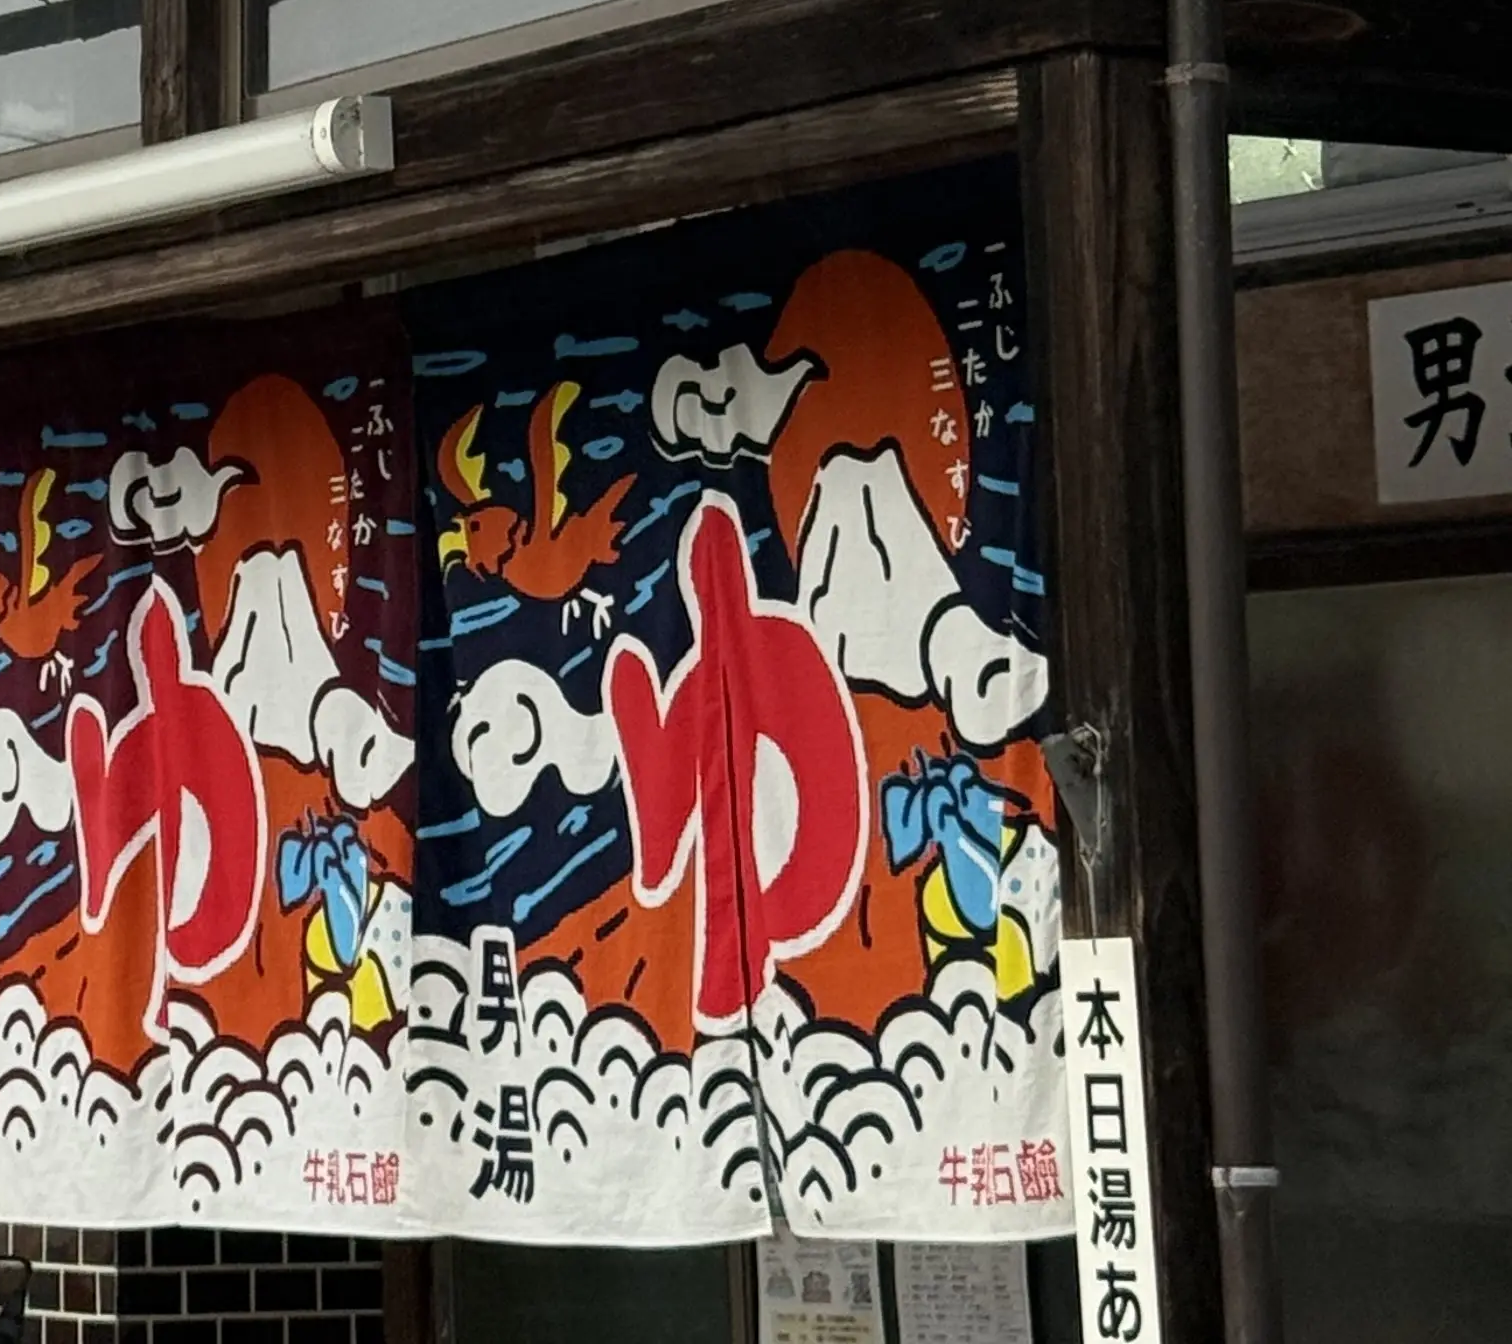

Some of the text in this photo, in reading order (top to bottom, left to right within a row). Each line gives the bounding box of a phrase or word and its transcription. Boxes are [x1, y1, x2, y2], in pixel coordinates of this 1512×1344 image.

[956, 299, 995, 438] 二たか
[984, 241, 1020, 361] 一ふじ
[366, 377, 394, 482] 一ふじ
[928, 357, 972, 549] 三なすび
[1402, 316, 1512, 469] 男
[326, 474, 350, 640] 三なすび
[65, 574, 264, 1044] ゆ
[602, 489, 869, 1033] ゆ
[469, 940, 535, 1204] 男湯
[1075, 977, 1142, 1343] 本日湯あ
